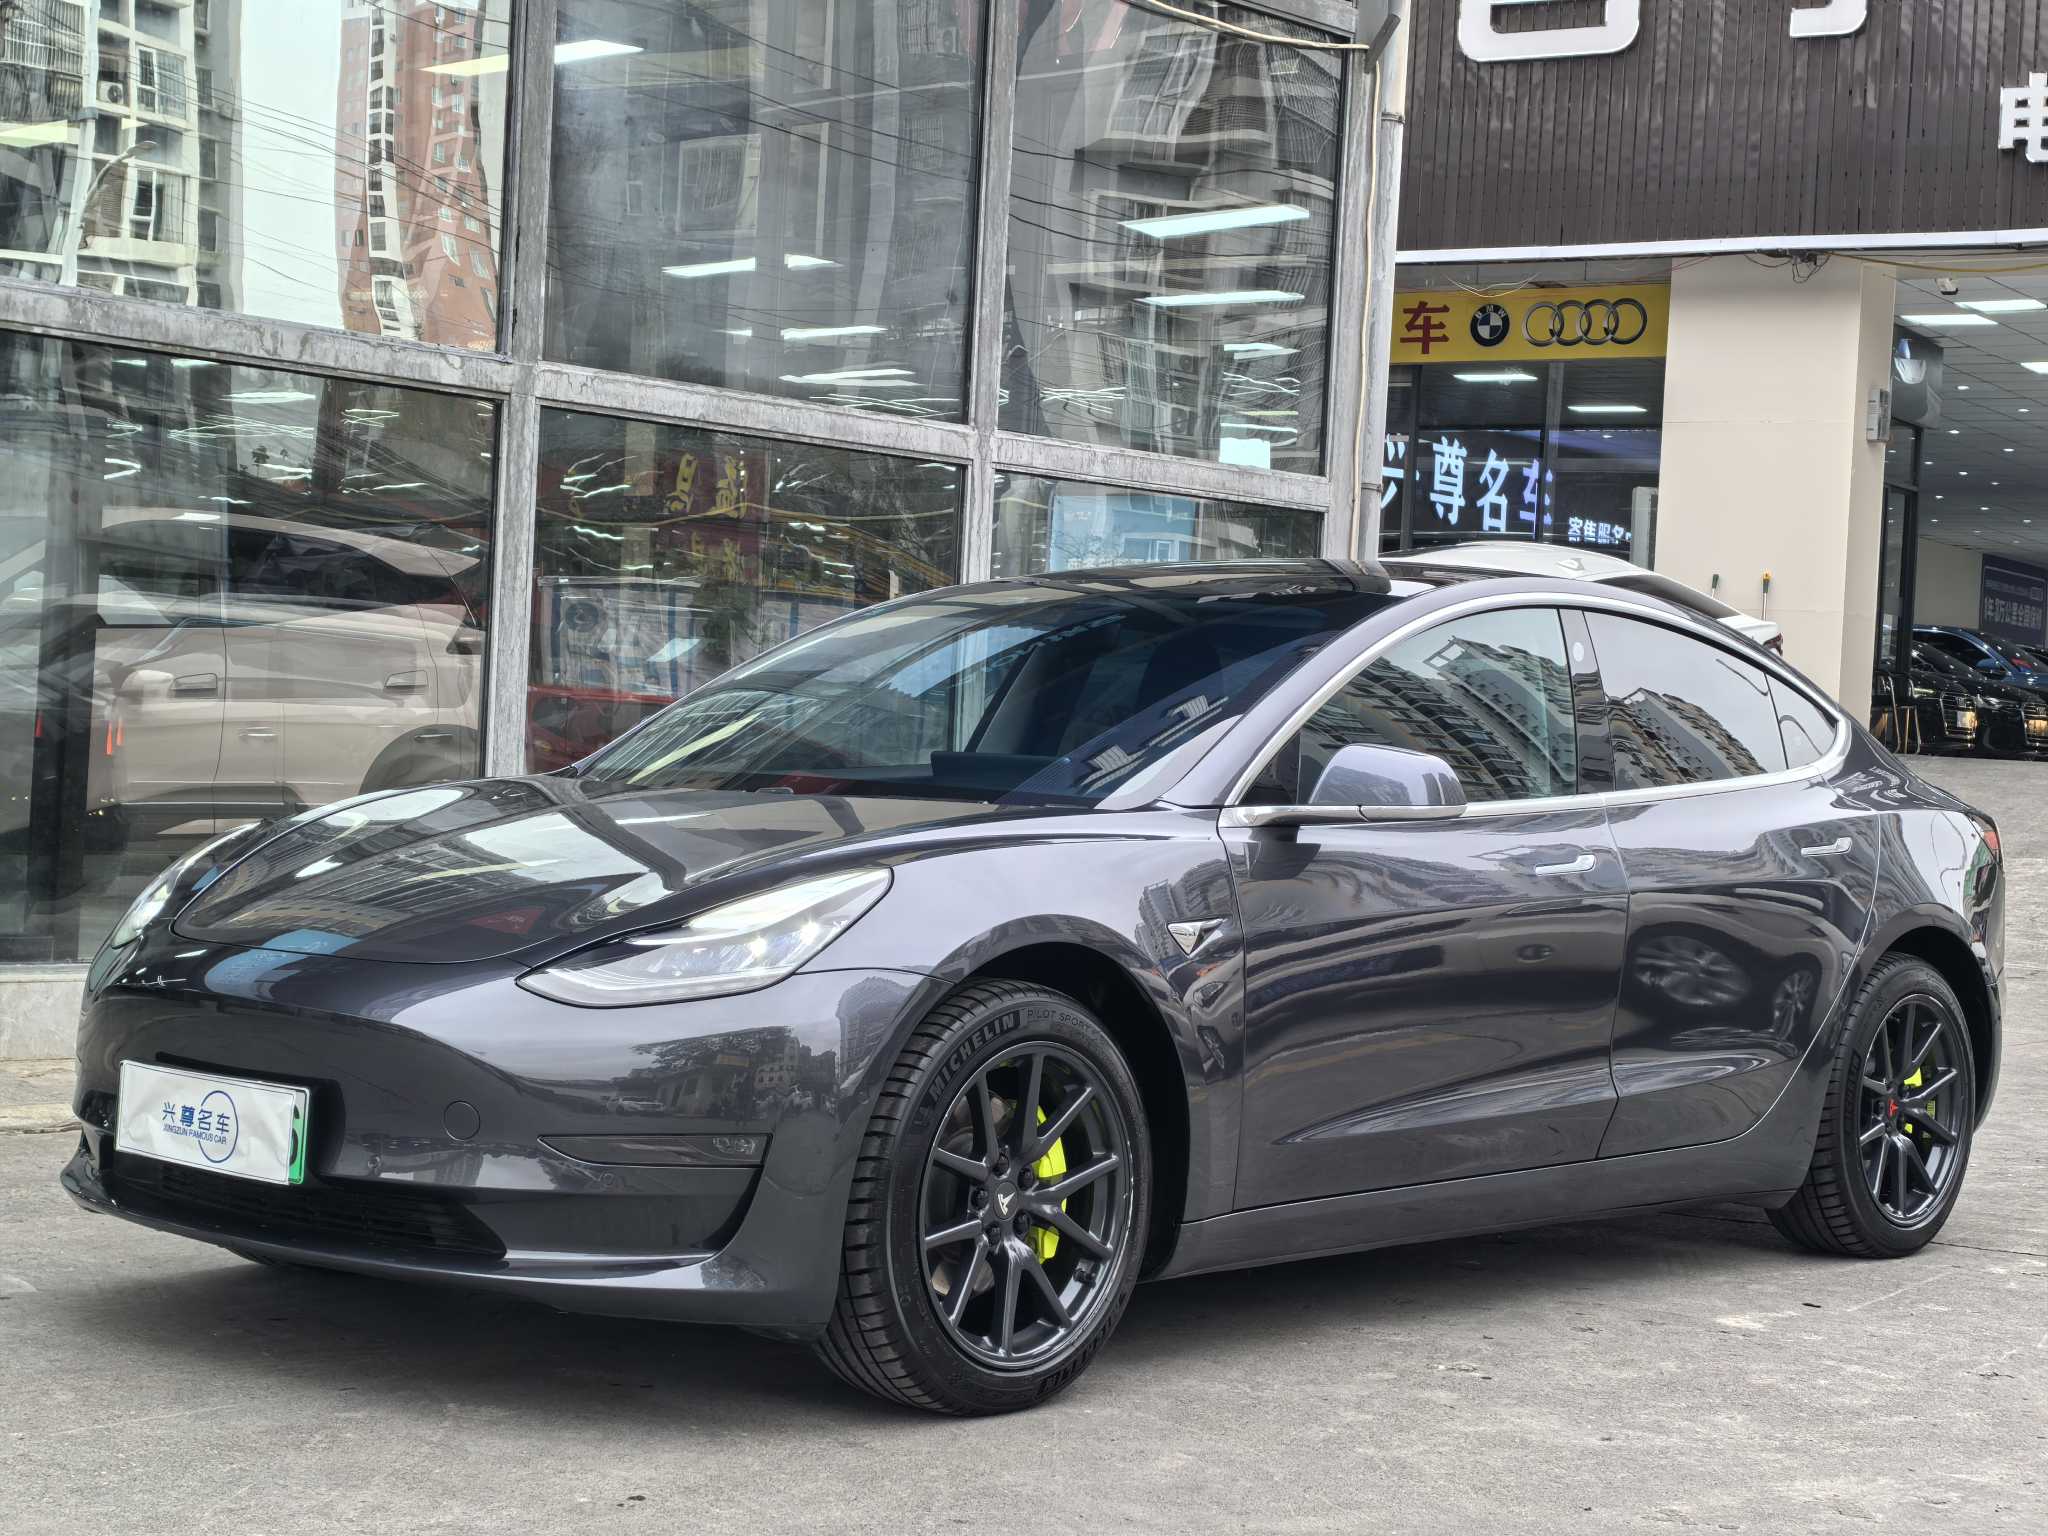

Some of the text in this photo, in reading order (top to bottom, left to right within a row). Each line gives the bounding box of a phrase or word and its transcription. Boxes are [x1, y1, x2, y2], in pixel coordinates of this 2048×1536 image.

[1399, 300, 1451, 355] 车
[927, 1012, 1017, 1101] MICHELIN
[161, 1101, 231, 1135] 兴尊名车
[188, 1128, 213, 1142] FAMOUS
[213, 1134, 227, 1145] CAR
